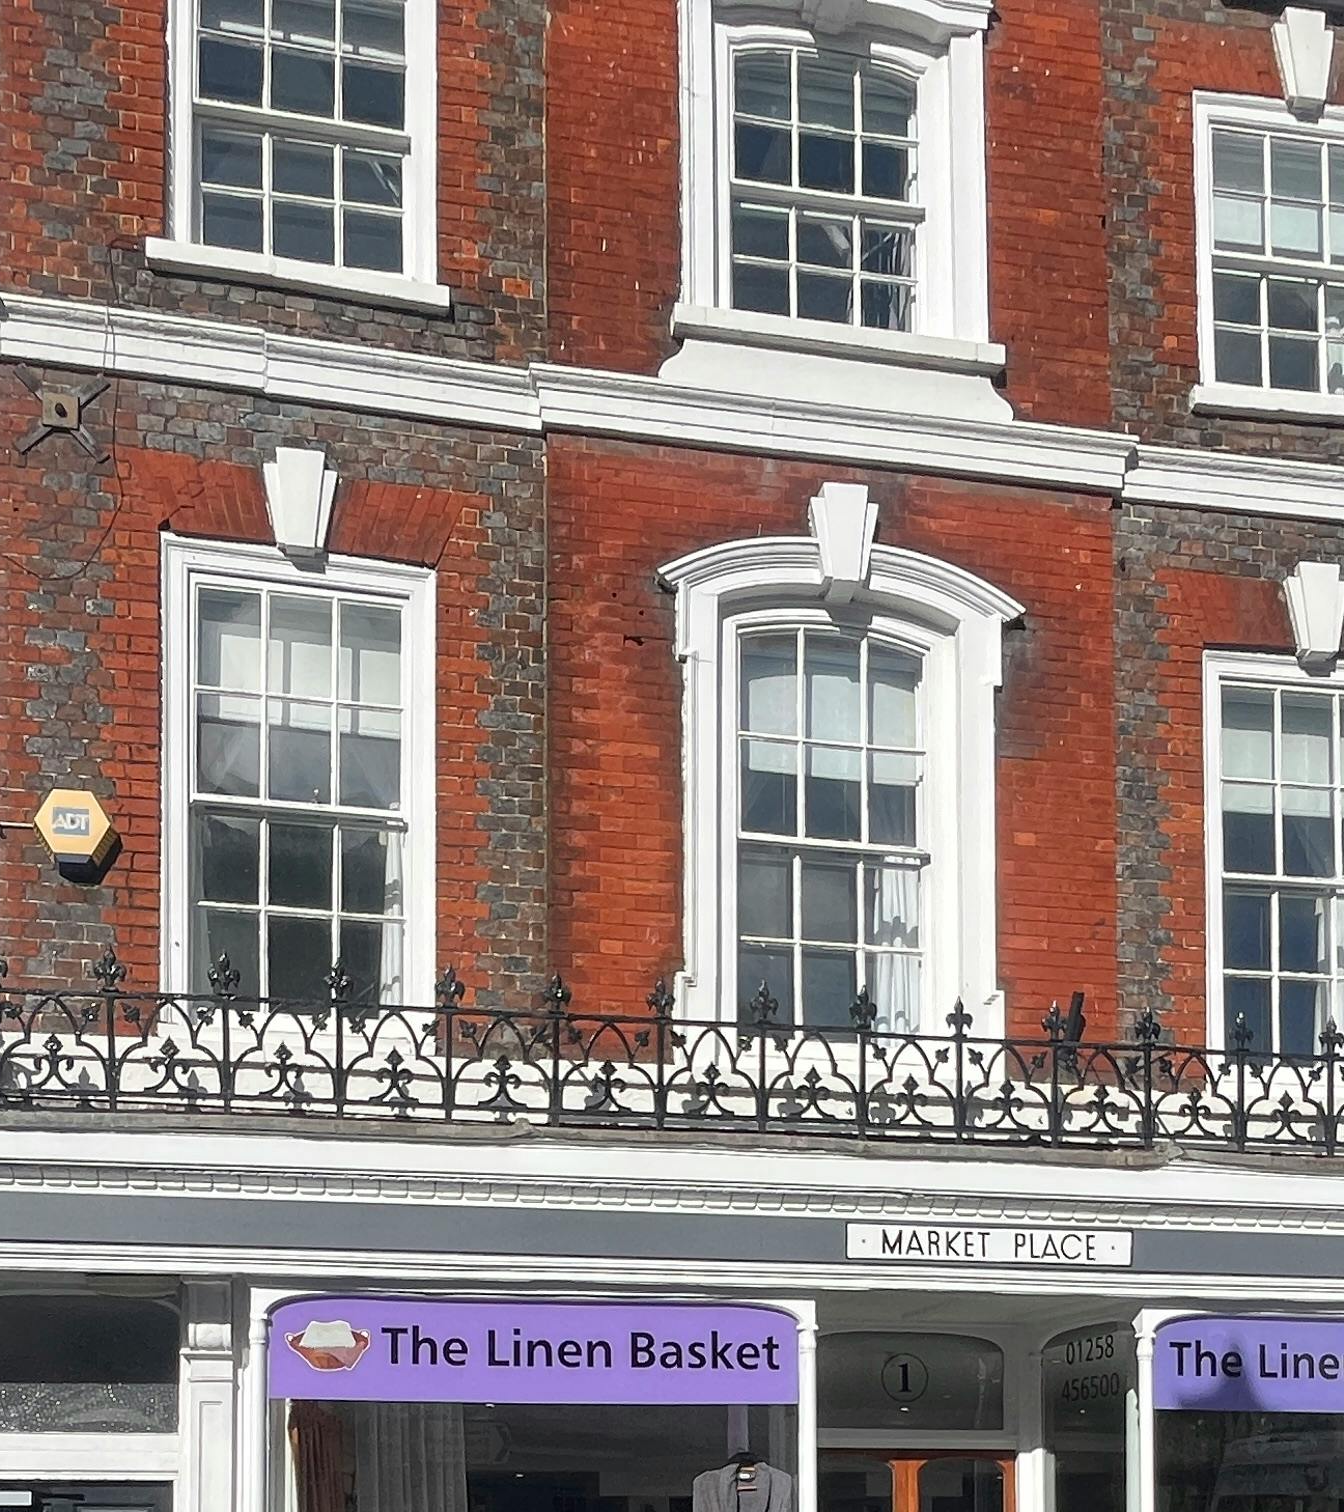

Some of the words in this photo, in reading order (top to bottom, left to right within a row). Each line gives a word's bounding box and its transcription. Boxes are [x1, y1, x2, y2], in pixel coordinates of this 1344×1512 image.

[53, 813, 89, 830] ADT
[882, 1229, 991, 1257] MARKET
[1014, 1233, 1097, 1261] PLACE
[381, 1325, 469, 1367] The
[487, 1328, 612, 1369] Linen
[630, 1330, 780, 1371] Basket
[1066, 1335, 1114, 1365] 01258
[1169, 1340, 1244, 1378] The
[898, 1363, 912, 1392] 1
[1062, 1373, 1120, 1400] 456500
